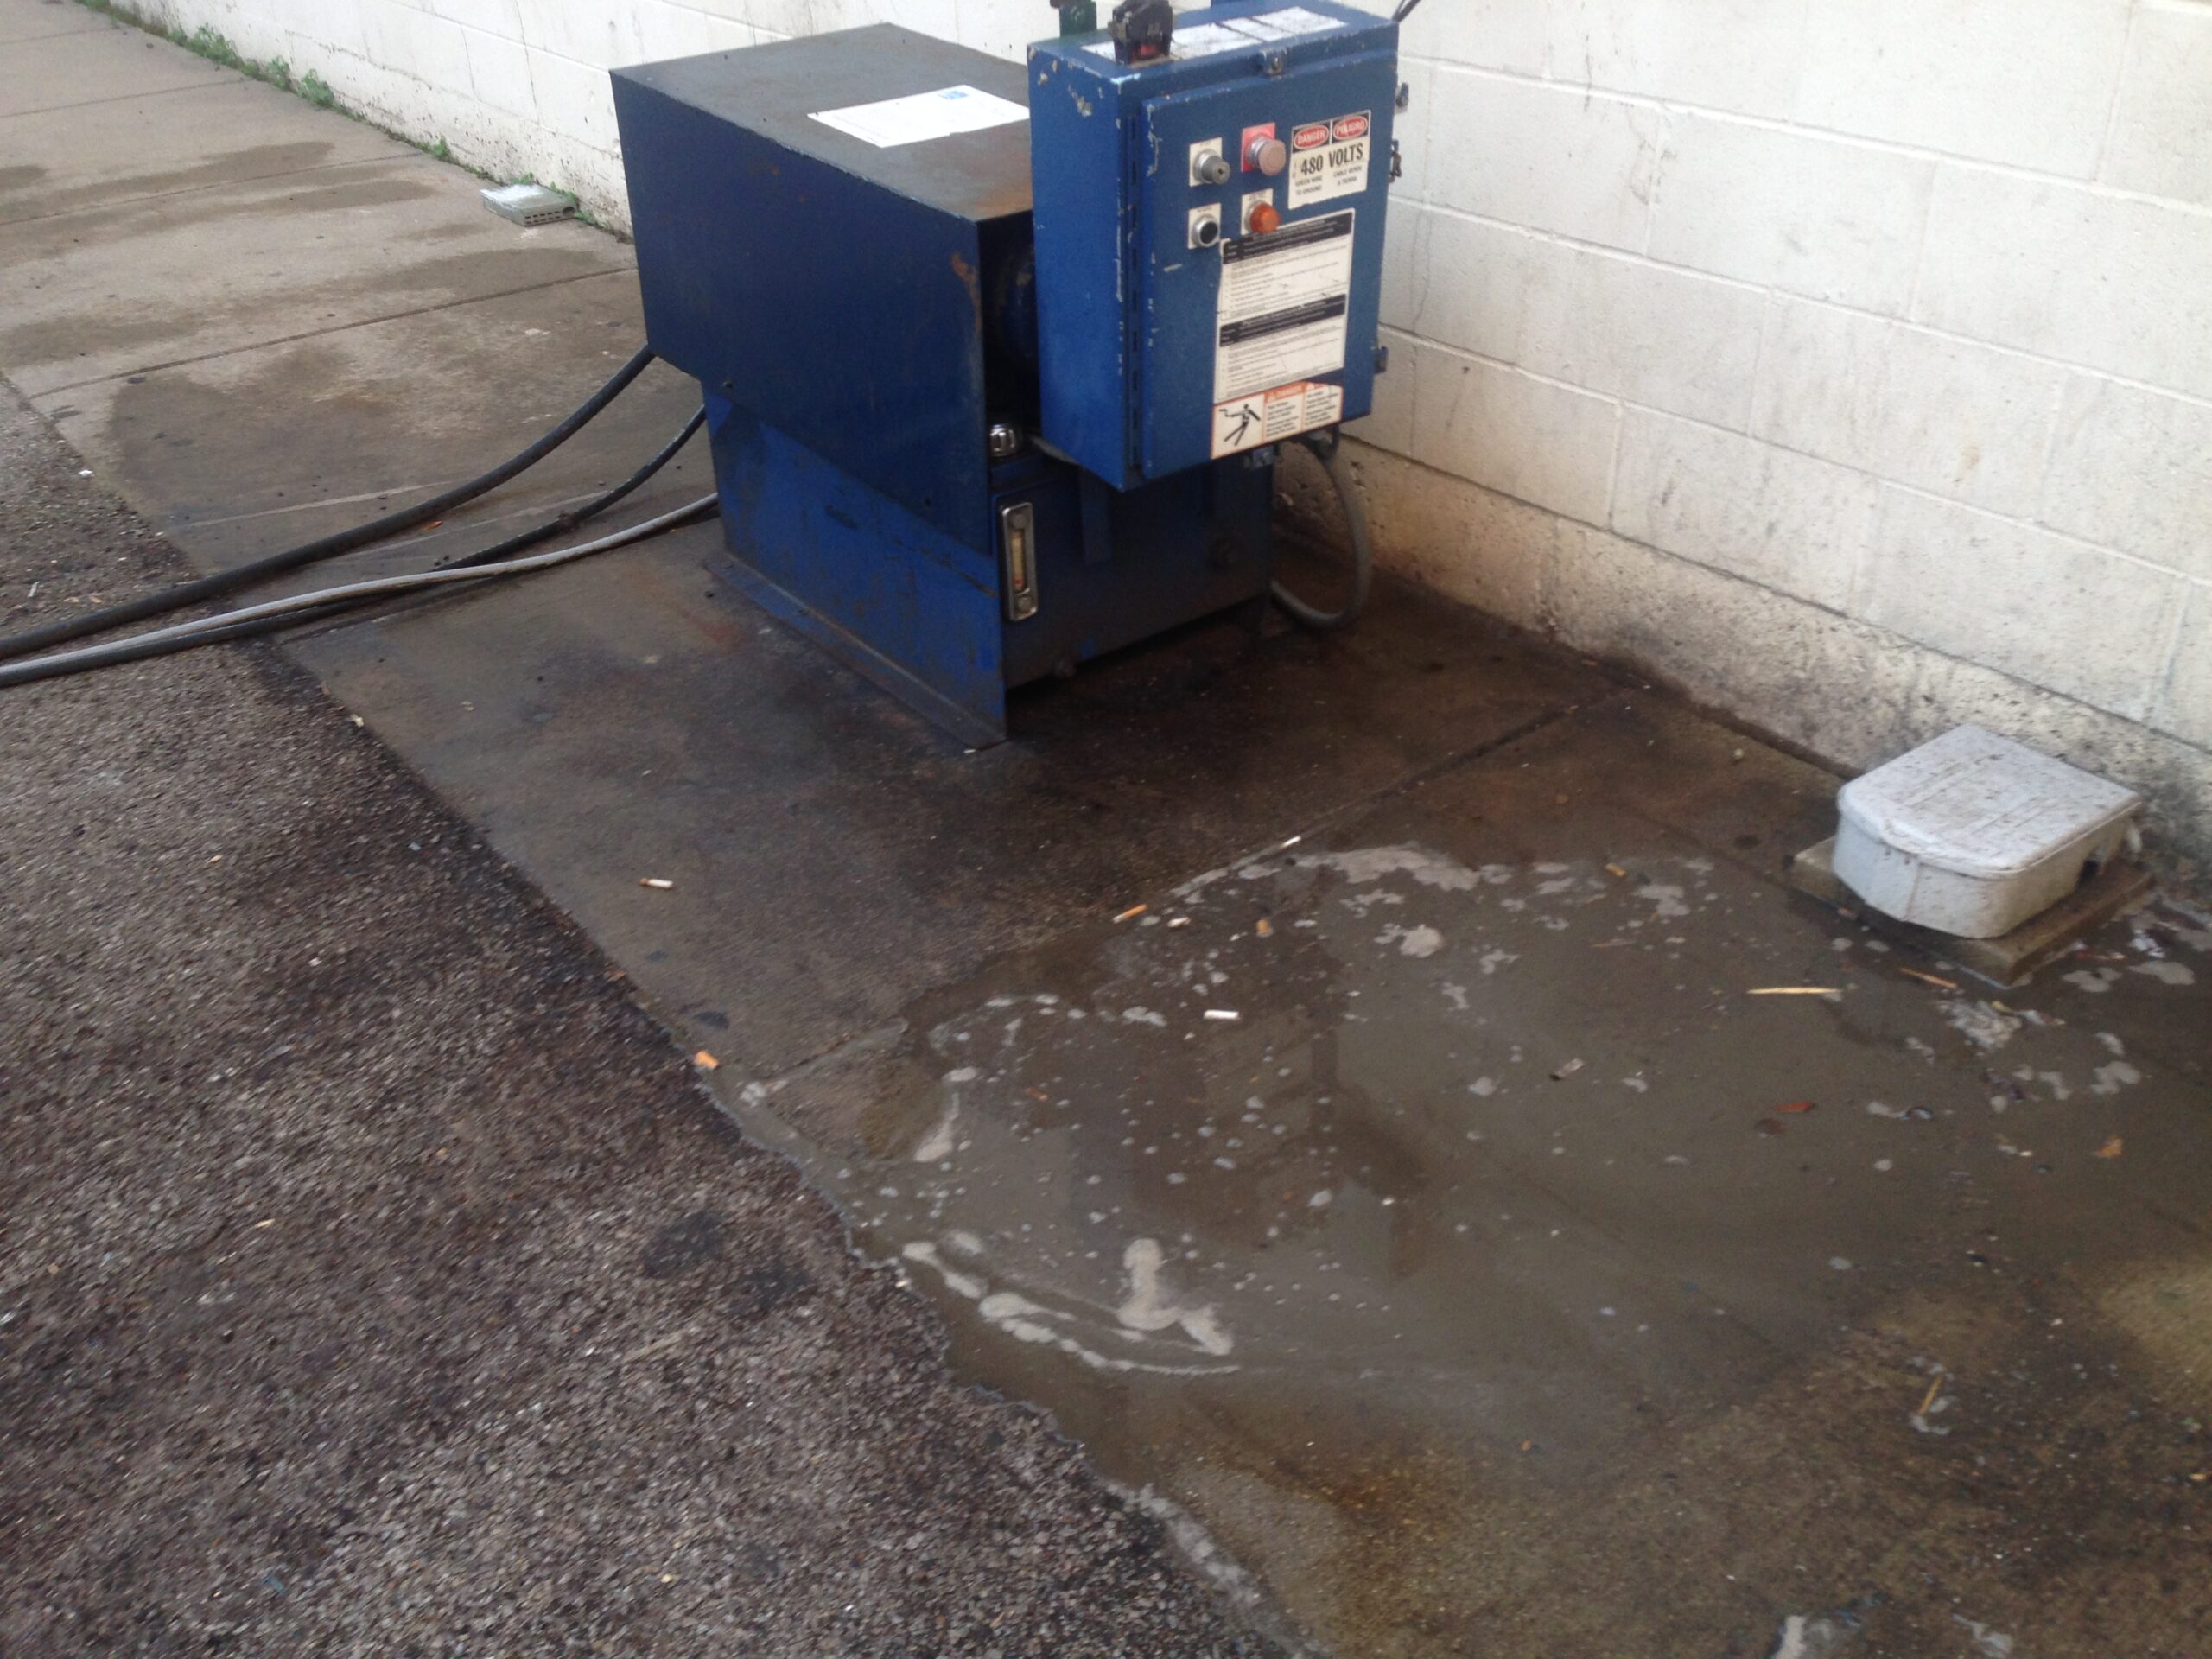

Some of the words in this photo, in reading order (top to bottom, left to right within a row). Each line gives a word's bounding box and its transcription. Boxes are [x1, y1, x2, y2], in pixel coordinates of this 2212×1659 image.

[1298, 130, 1325, 143] DANGER
[1301, 155, 1324, 175] 480
[1329, 143, 1363, 168] VOLTS
